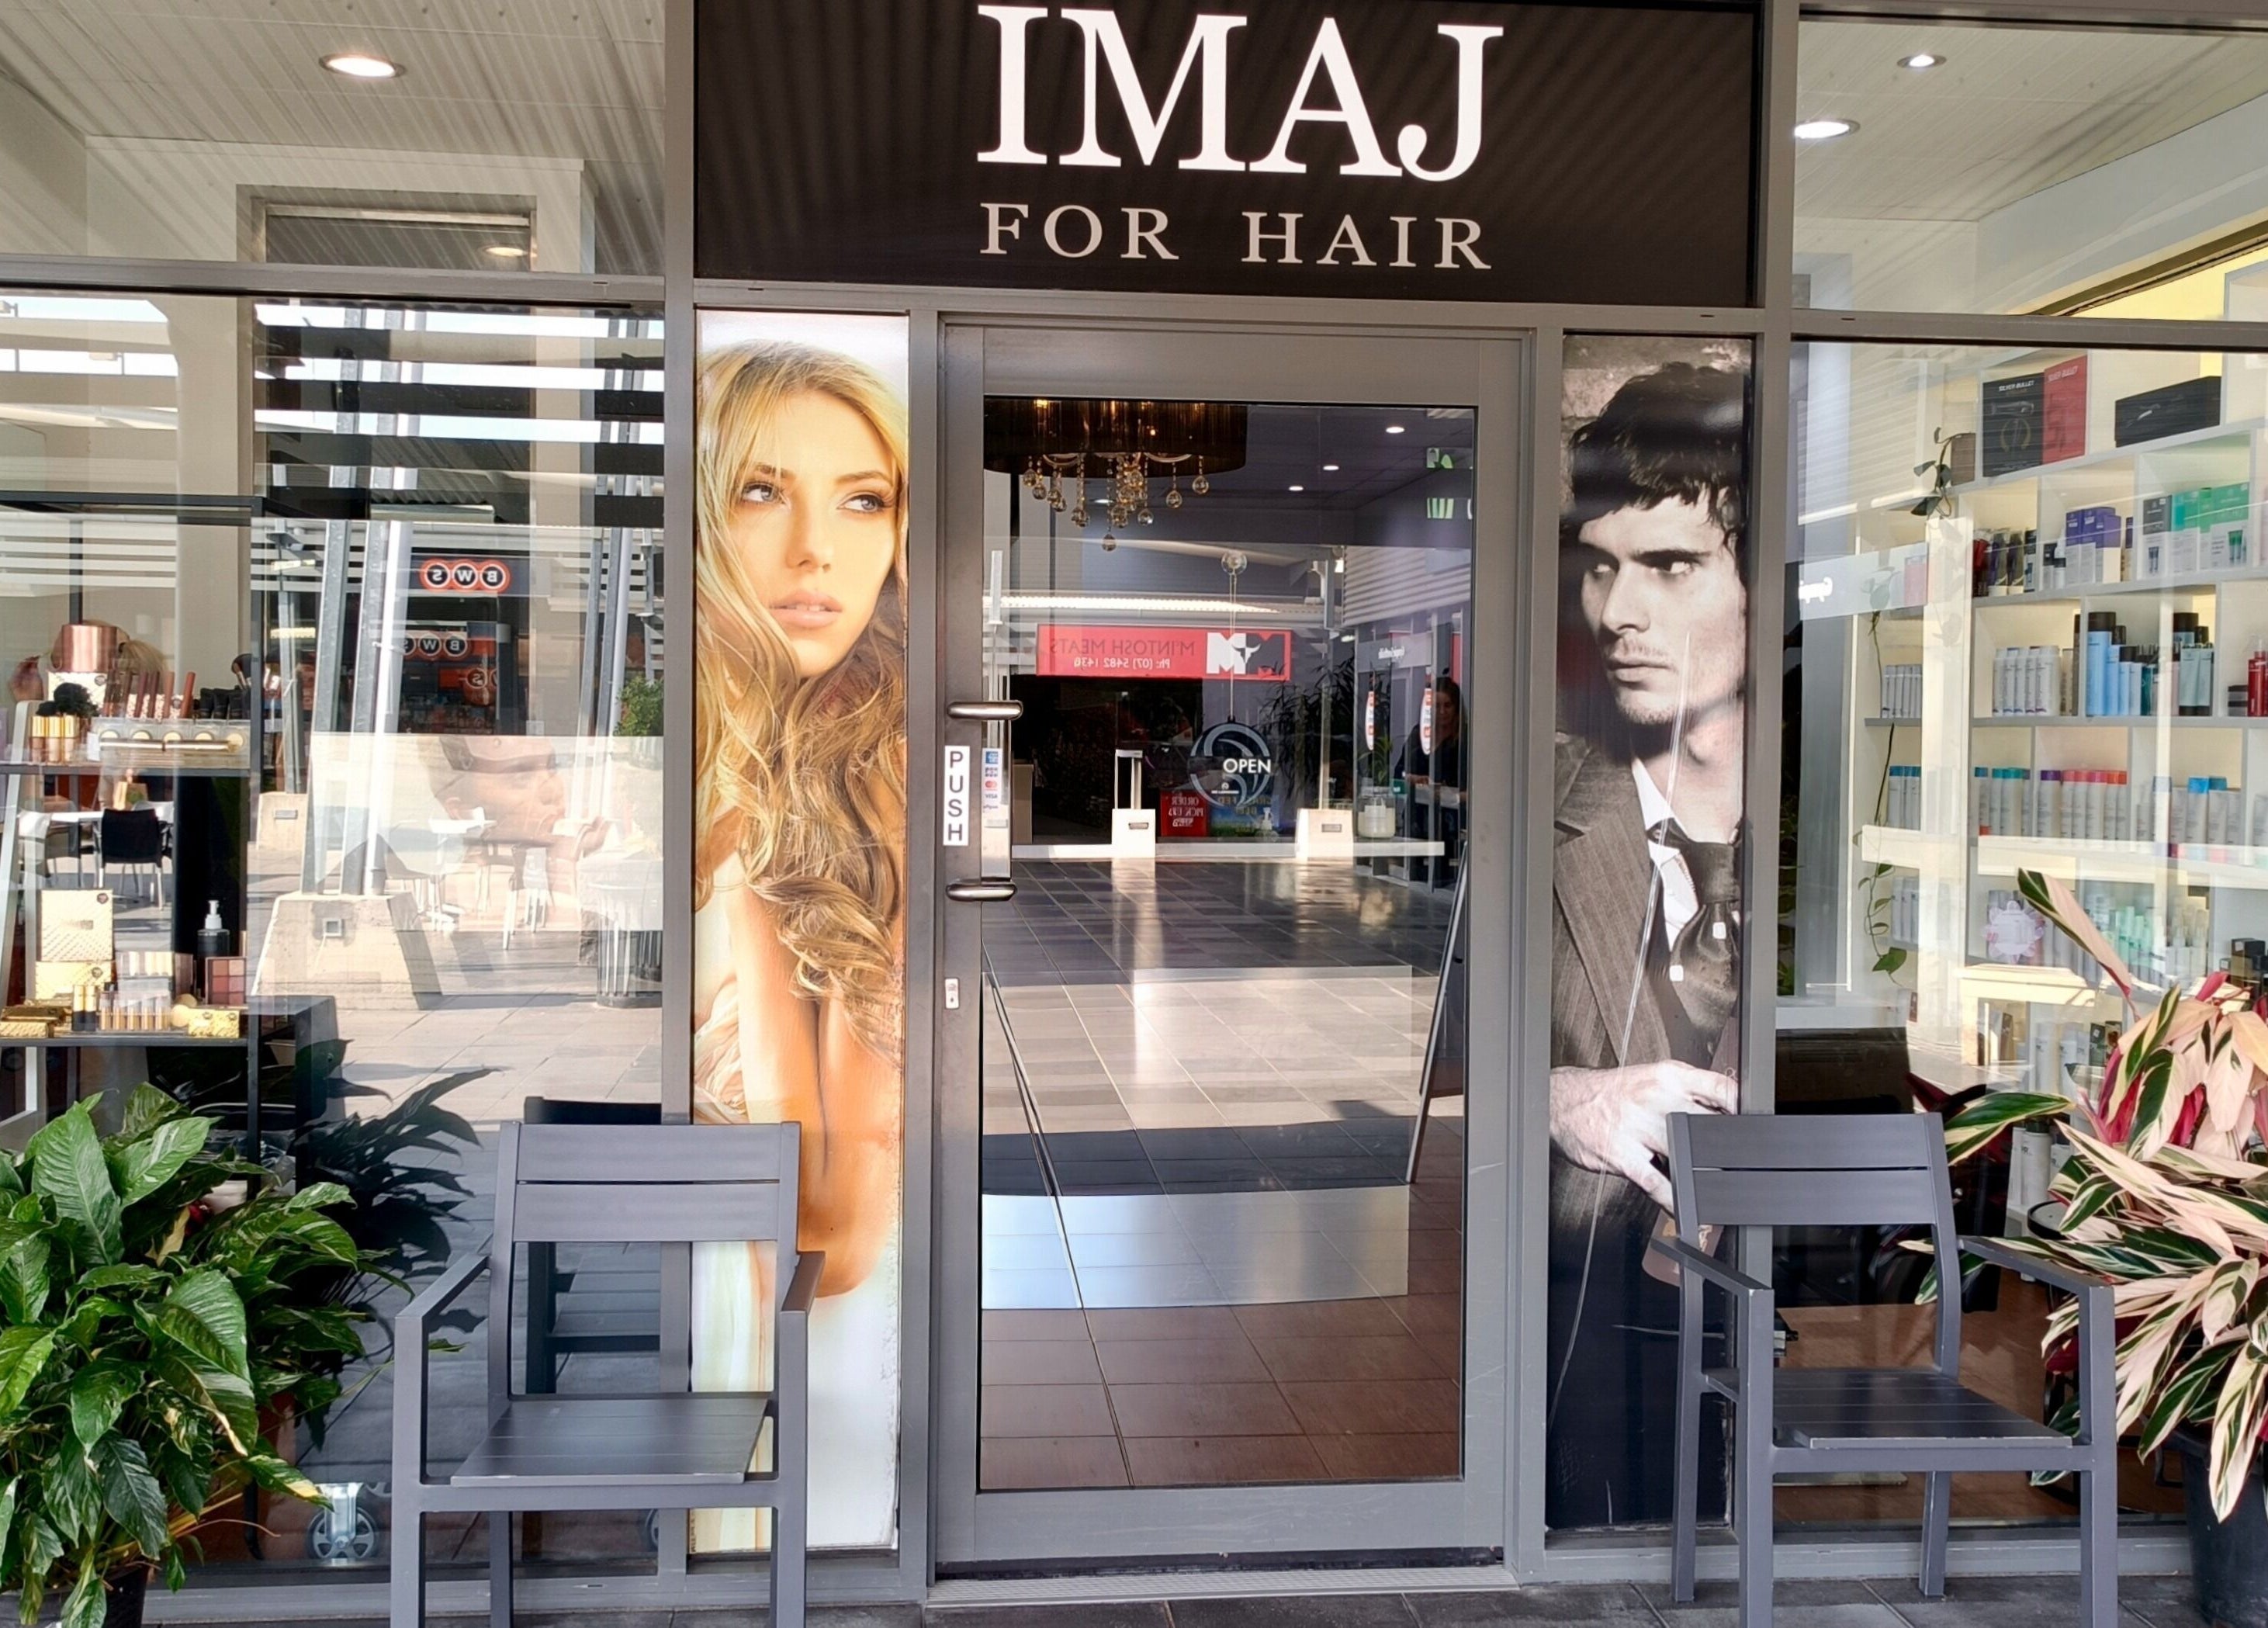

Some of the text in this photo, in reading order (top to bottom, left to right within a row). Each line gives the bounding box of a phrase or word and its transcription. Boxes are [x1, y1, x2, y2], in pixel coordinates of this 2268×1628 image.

[977, 5, 1504, 182] IMAJ
[980, 203, 1492, 269] FOR HAIR
[948, 751, 964, 841] PUSH
[1223, 758, 1271, 774] OPEN
